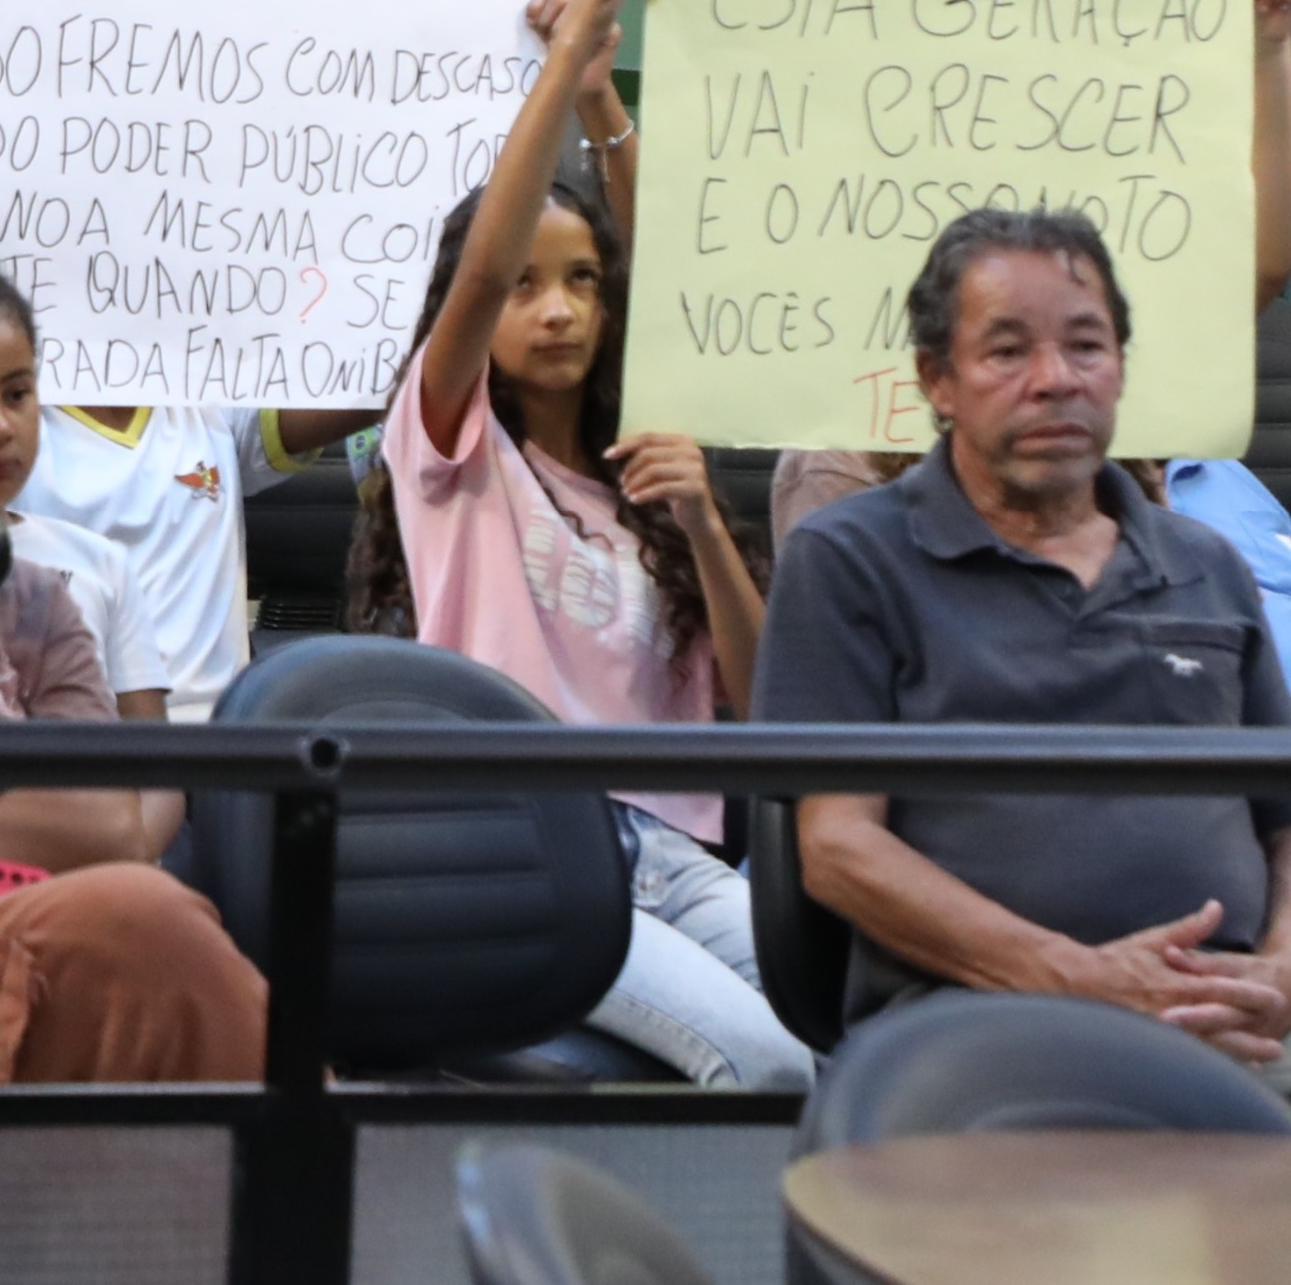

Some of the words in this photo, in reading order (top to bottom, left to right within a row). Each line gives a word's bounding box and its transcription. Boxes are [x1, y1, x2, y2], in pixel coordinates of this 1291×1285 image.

[284, 36, 375, 103] COM
[391, 49, 543, 106] DESCASO
[59, 117, 214, 184] PODER
[863, 61, 1191, 166] CRESCER
[144, 188, 319, 264] MESMA
[696, 177, 728, 255] E
[764, 183, 800, 246] O
[346, 273, 409, 331] SE
[184, 324, 290, 402] FALTA
